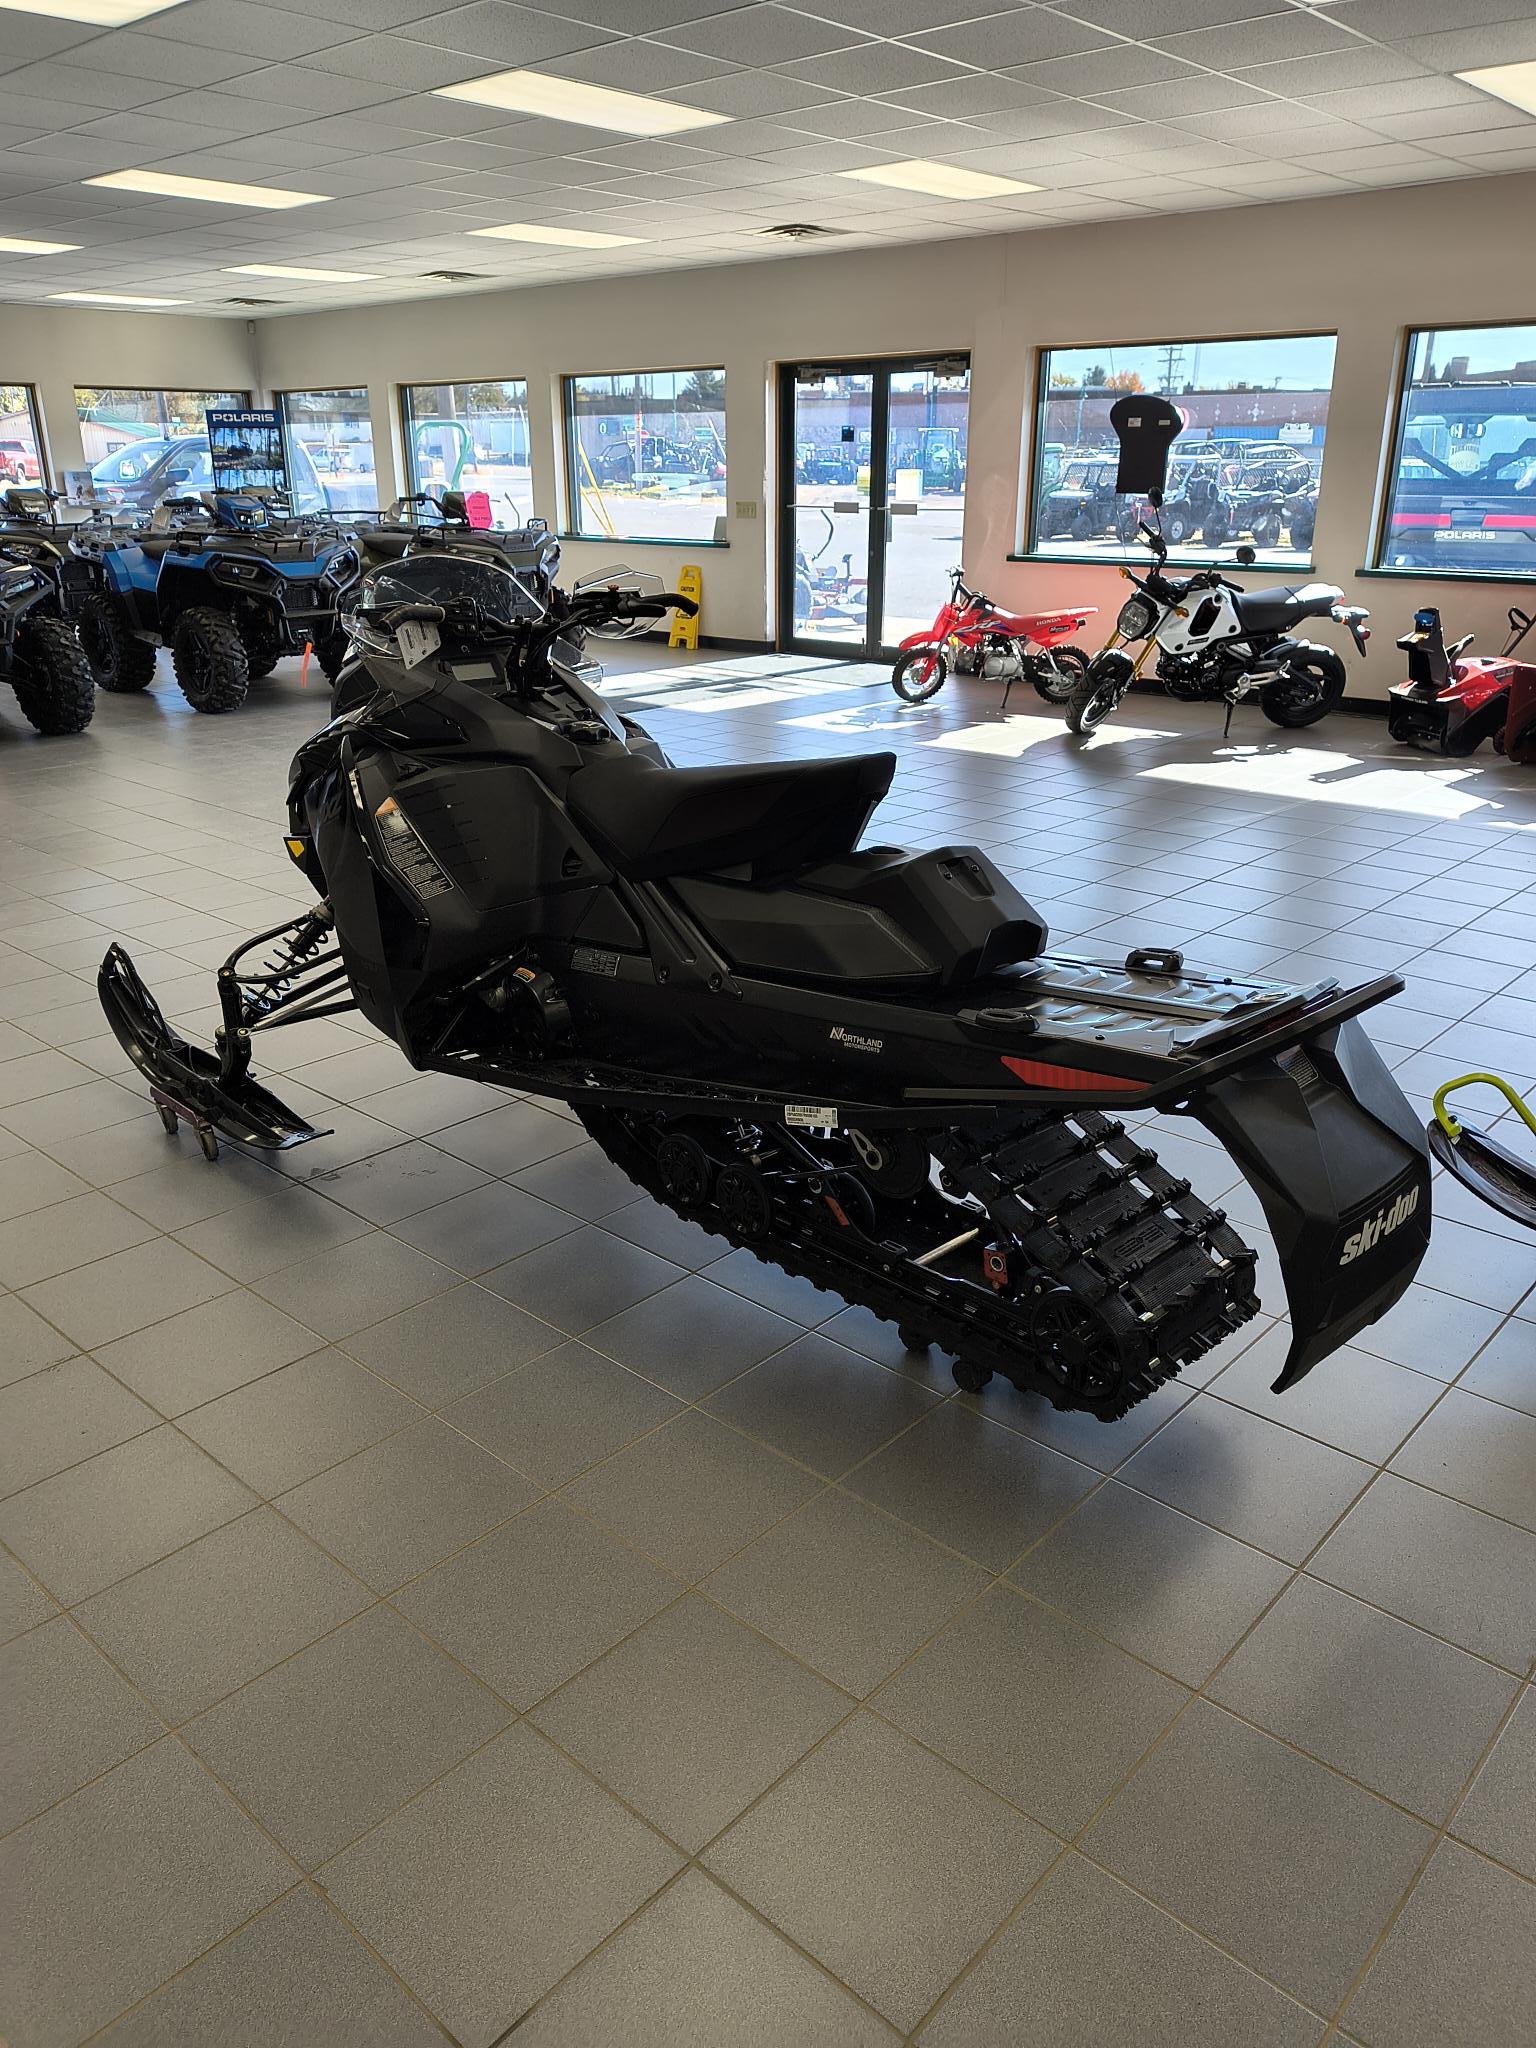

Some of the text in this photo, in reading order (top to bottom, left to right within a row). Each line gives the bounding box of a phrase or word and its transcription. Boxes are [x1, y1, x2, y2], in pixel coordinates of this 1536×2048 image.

[212, 413, 275, 422] POLARIS
[1433, 530, 1496, 540] POLARIS
[1036, 617, 1061, 626] HONDA
[829, 1026, 883, 1048] NORTHLAND
[1339, 1184, 1419, 1266] ski-doo
